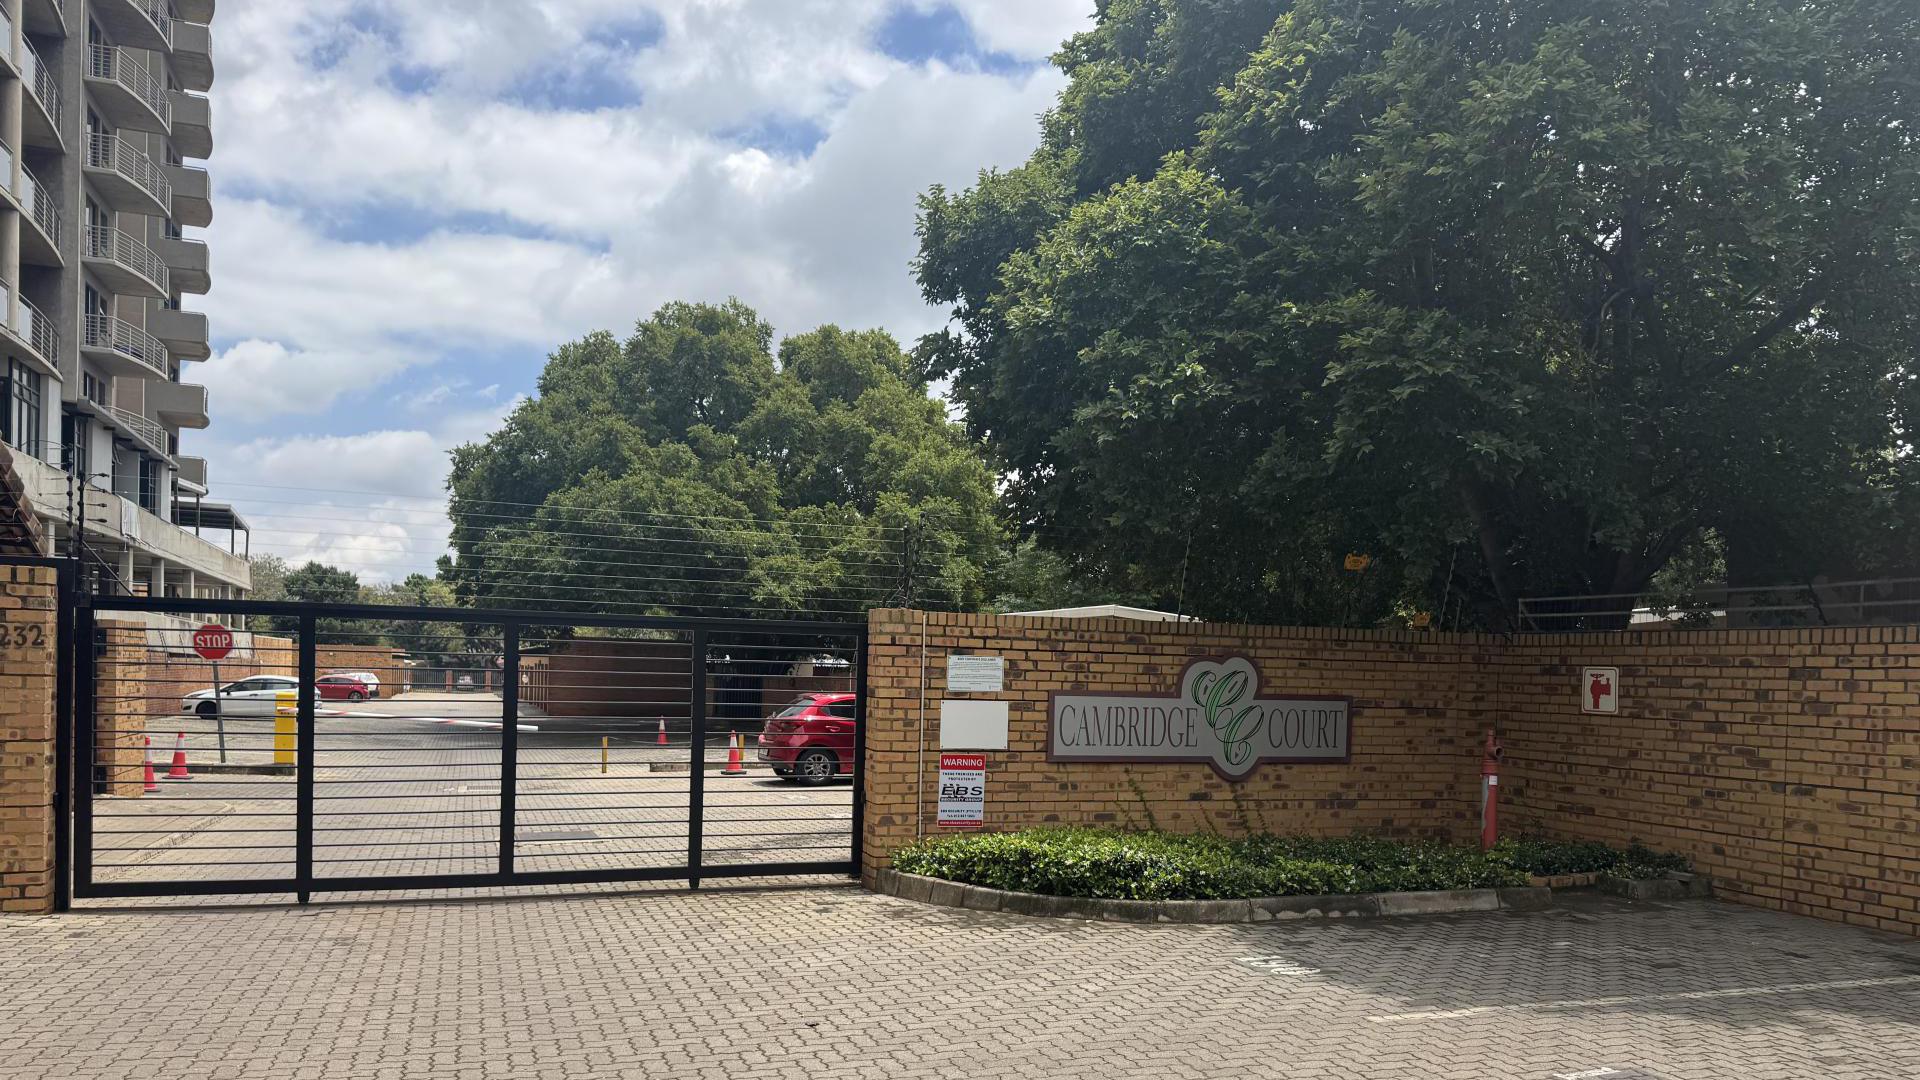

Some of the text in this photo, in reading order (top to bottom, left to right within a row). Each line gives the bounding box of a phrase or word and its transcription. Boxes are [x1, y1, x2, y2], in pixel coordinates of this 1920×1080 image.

[0, 624, 45, 646] 232
[196, 634, 231, 650] STOP
[1059, 704, 1344, 749] CAMBRIDGE COURT
[943, 758, 983, 767] WARNING
[941, 786, 983, 796] EBS
